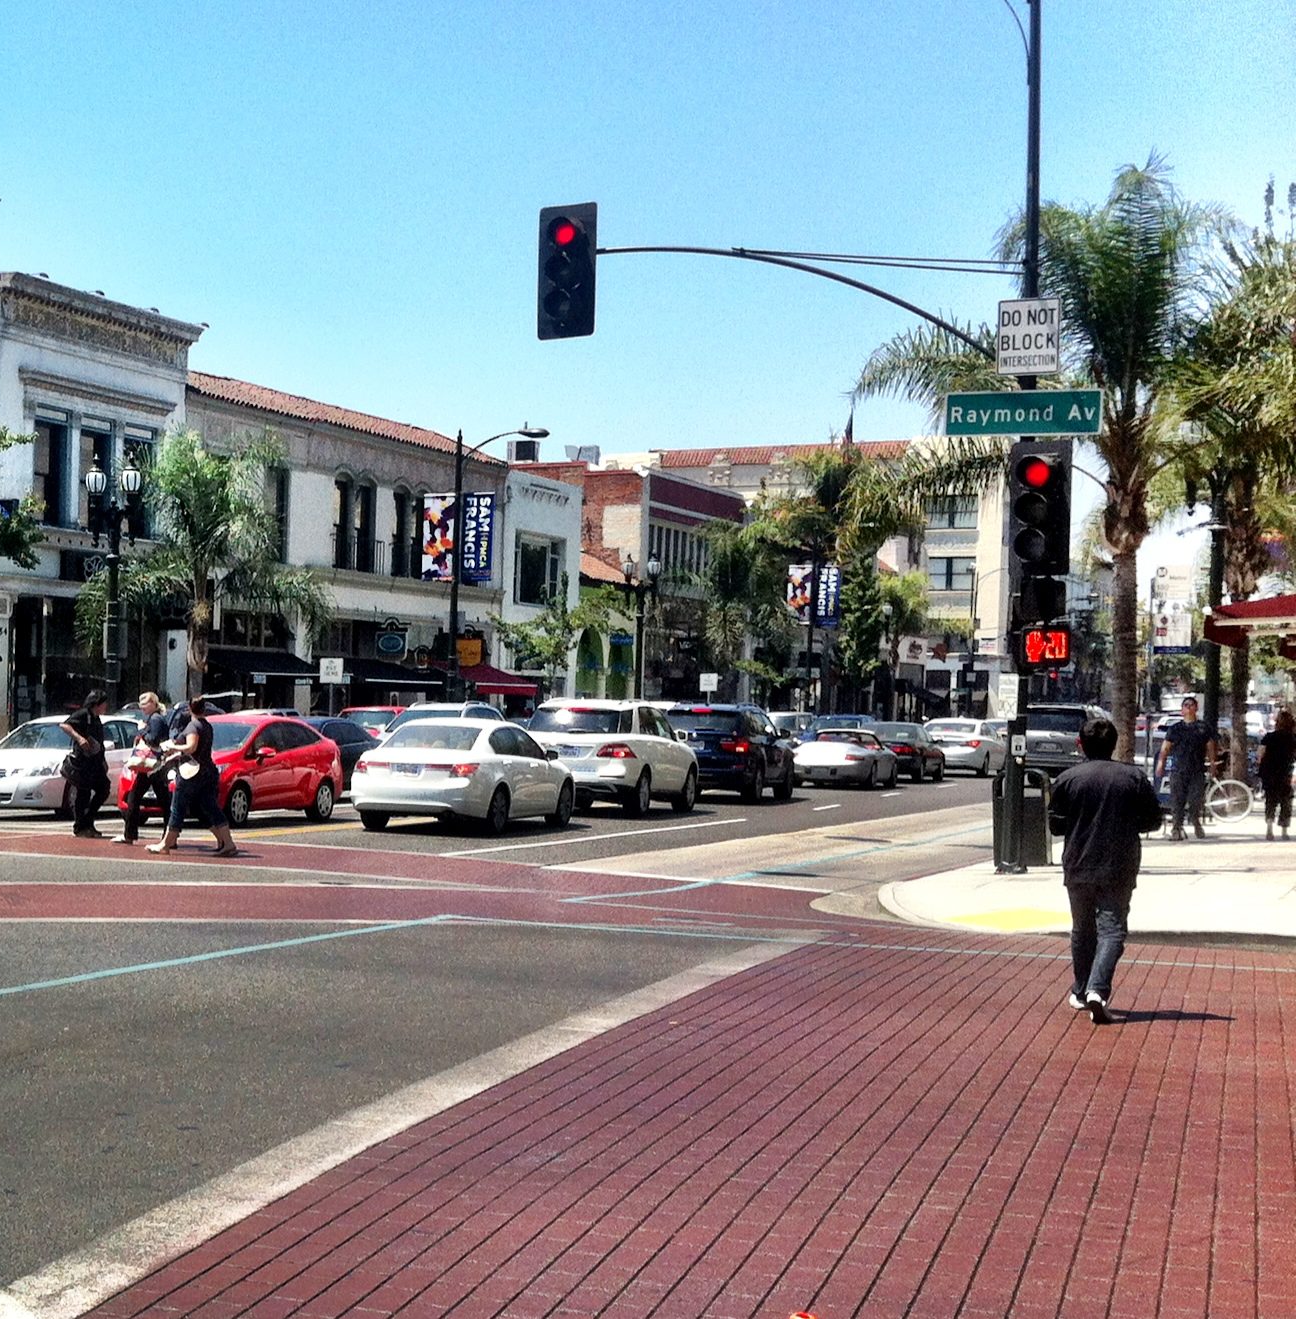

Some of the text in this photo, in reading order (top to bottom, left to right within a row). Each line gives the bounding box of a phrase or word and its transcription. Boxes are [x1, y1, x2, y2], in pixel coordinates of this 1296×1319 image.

[1002, 308, 1056, 327] DO NOT
[1001, 333, 1055, 351] BLOCK
[1000, 354, 1056, 367] INTERSECTION
[950, 404, 1095, 426] Raymond Av
[479, 497, 492, 533] SAM
[464, 497, 477, 568] FRANCIS
[827, 568, 838, 592] SAM
[817, 568, 829, 616] FRANCIS
